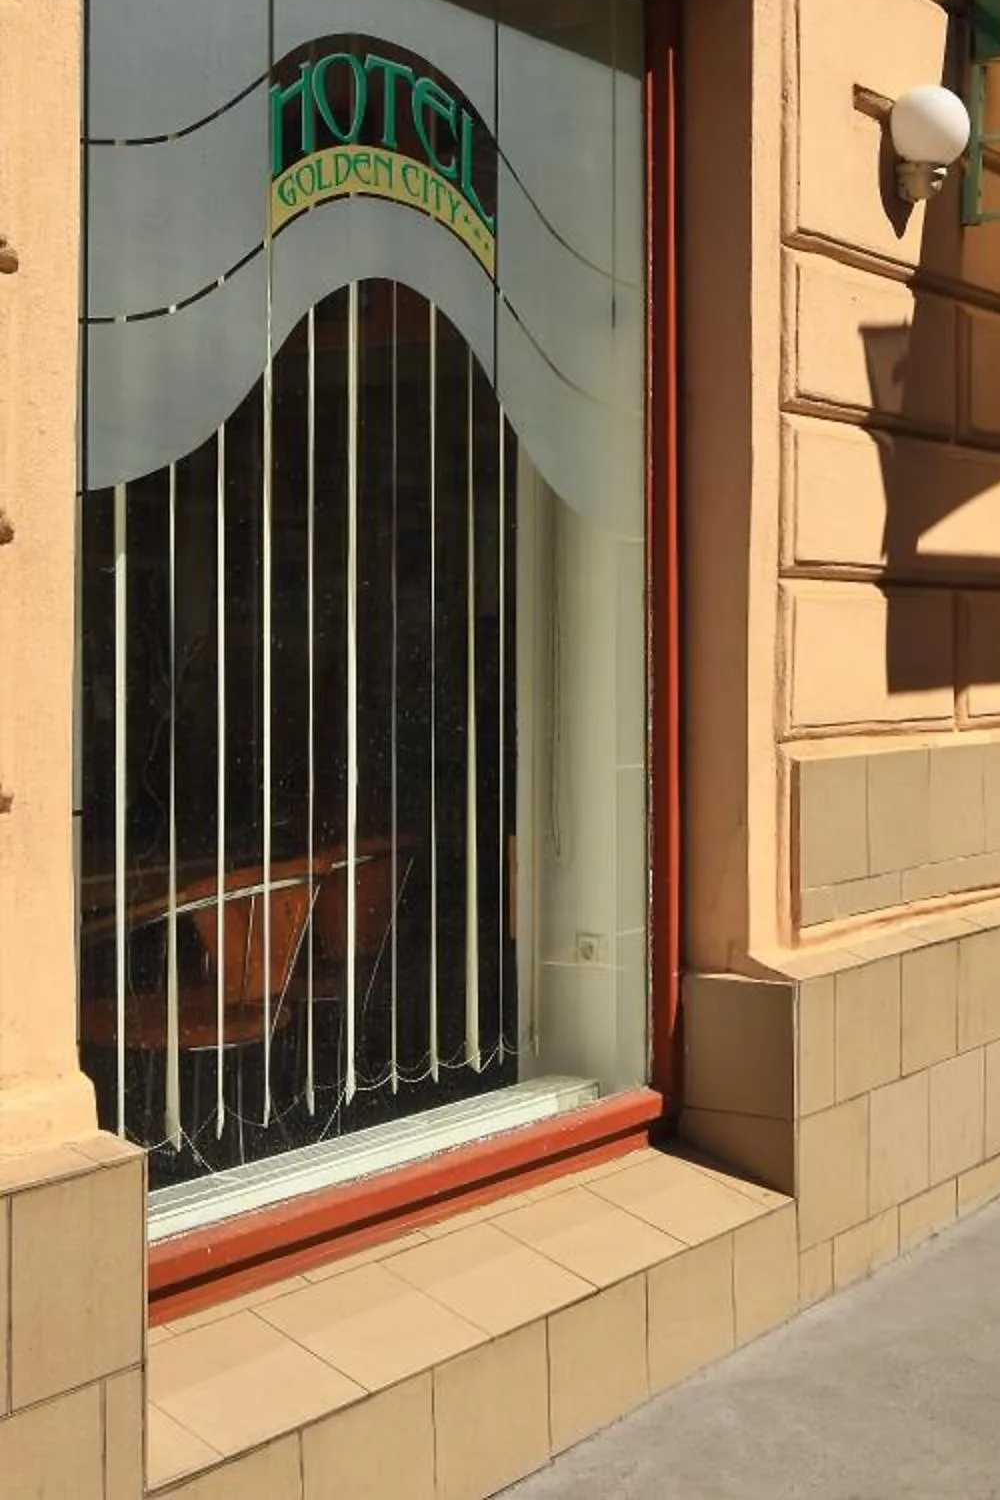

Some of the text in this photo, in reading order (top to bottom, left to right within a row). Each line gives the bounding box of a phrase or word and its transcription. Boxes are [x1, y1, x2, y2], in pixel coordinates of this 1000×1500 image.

[270, 52, 496, 234] HOTEL
[277, 152, 461, 225] GOLDEN CITY
